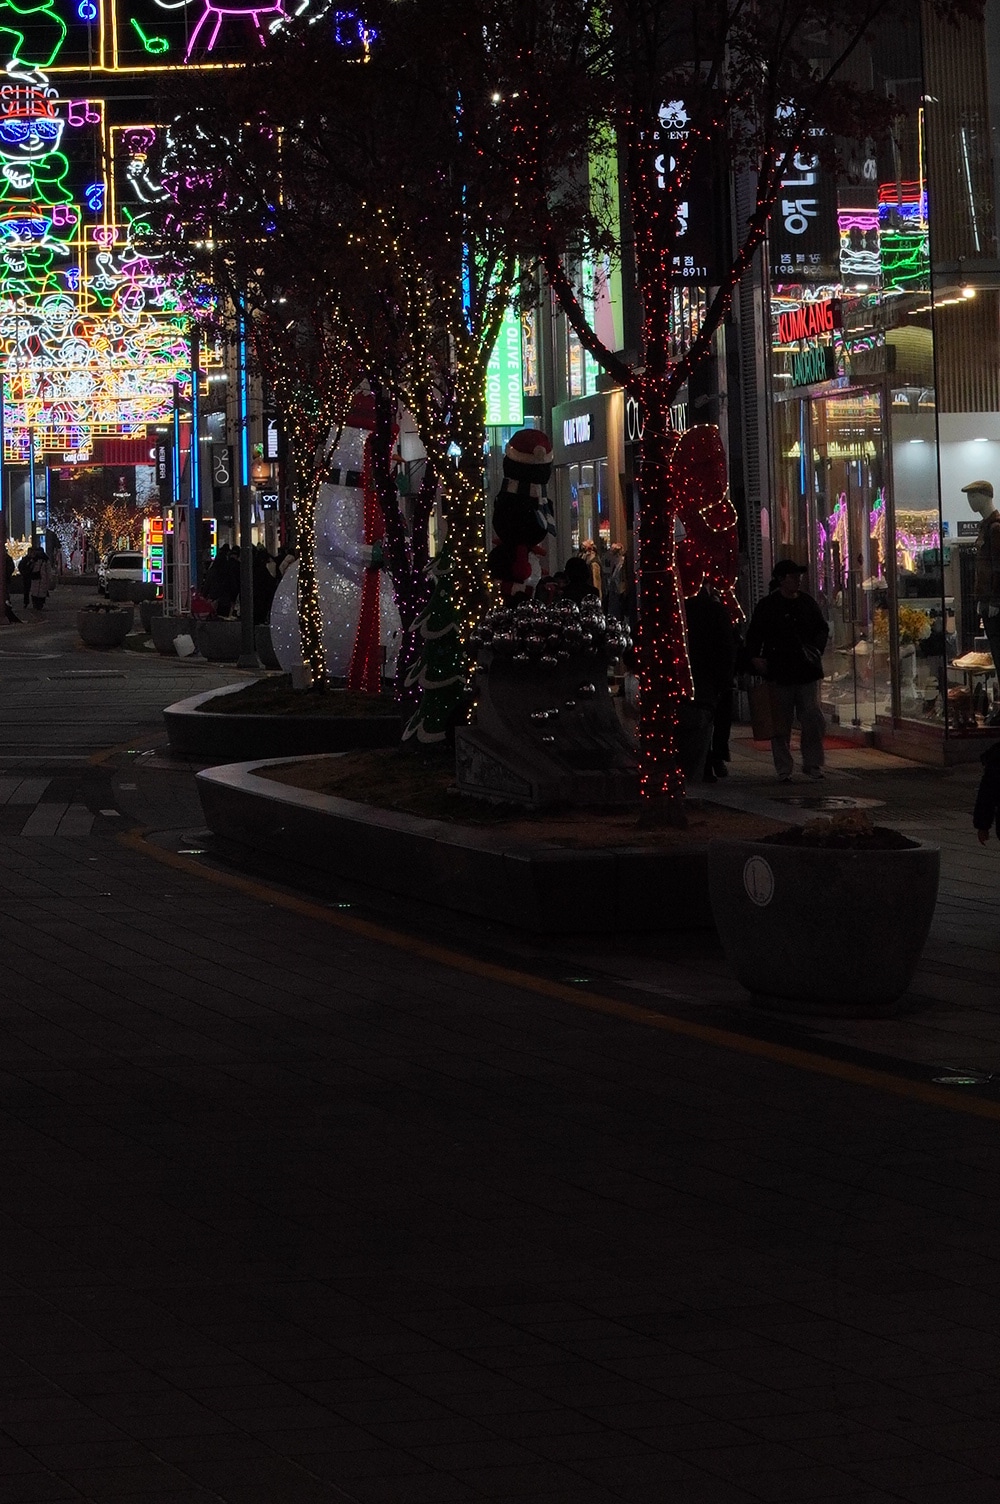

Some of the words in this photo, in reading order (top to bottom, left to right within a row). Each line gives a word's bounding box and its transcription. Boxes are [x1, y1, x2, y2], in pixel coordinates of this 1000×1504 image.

[779, 299, 834, 344] KUMKANG
[506, 327, 519, 369] OLIVE
[792, 345, 827, 387] LANDROVER
[489, 373, 502, 423] YOUNG
[508, 373, 521, 423] YOUNG
[158, 446, 167, 462] NEW
[158, 464, 167, 479] ERA
